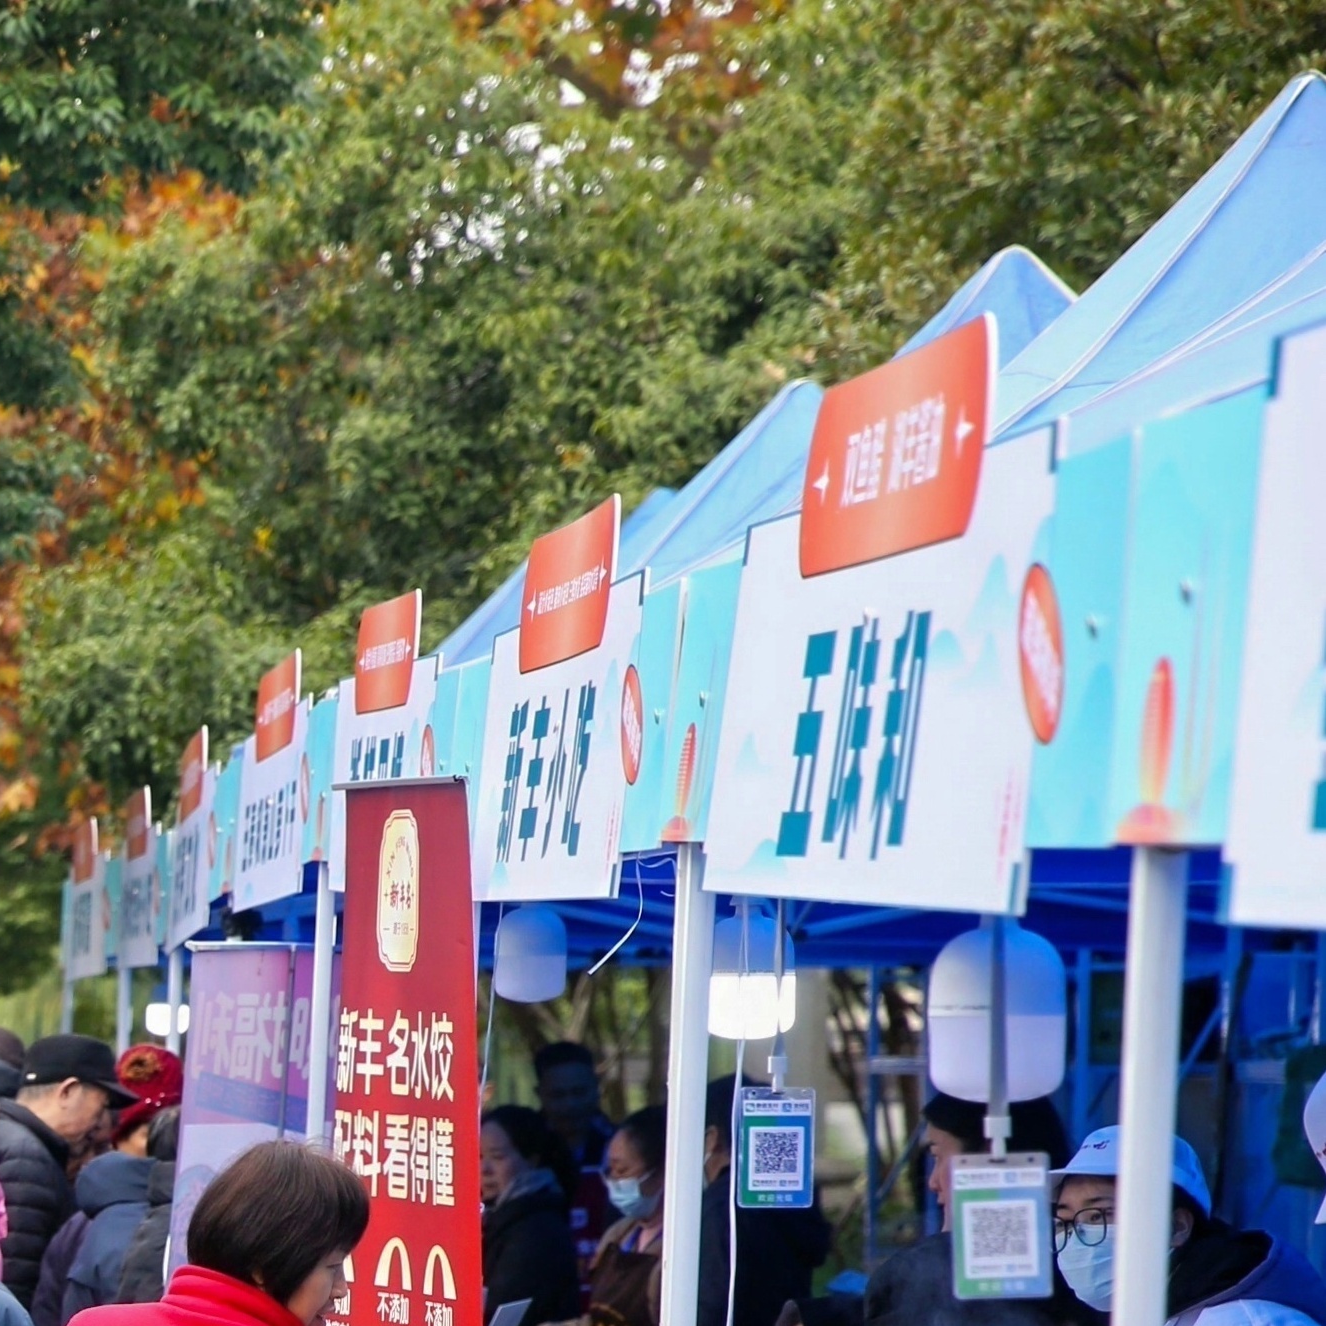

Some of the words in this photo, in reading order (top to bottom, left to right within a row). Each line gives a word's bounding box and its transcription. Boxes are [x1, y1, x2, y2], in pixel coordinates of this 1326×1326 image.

[496, 679, 596, 863] 新丰小吃
[776, 609, 932, 860] 五味和
[337, 1006, 454, 1102] 新丰名水饺
[333, 1109, 455, 1206] 配料看得懂
[377, 1291, 410, 1325] 不添加
